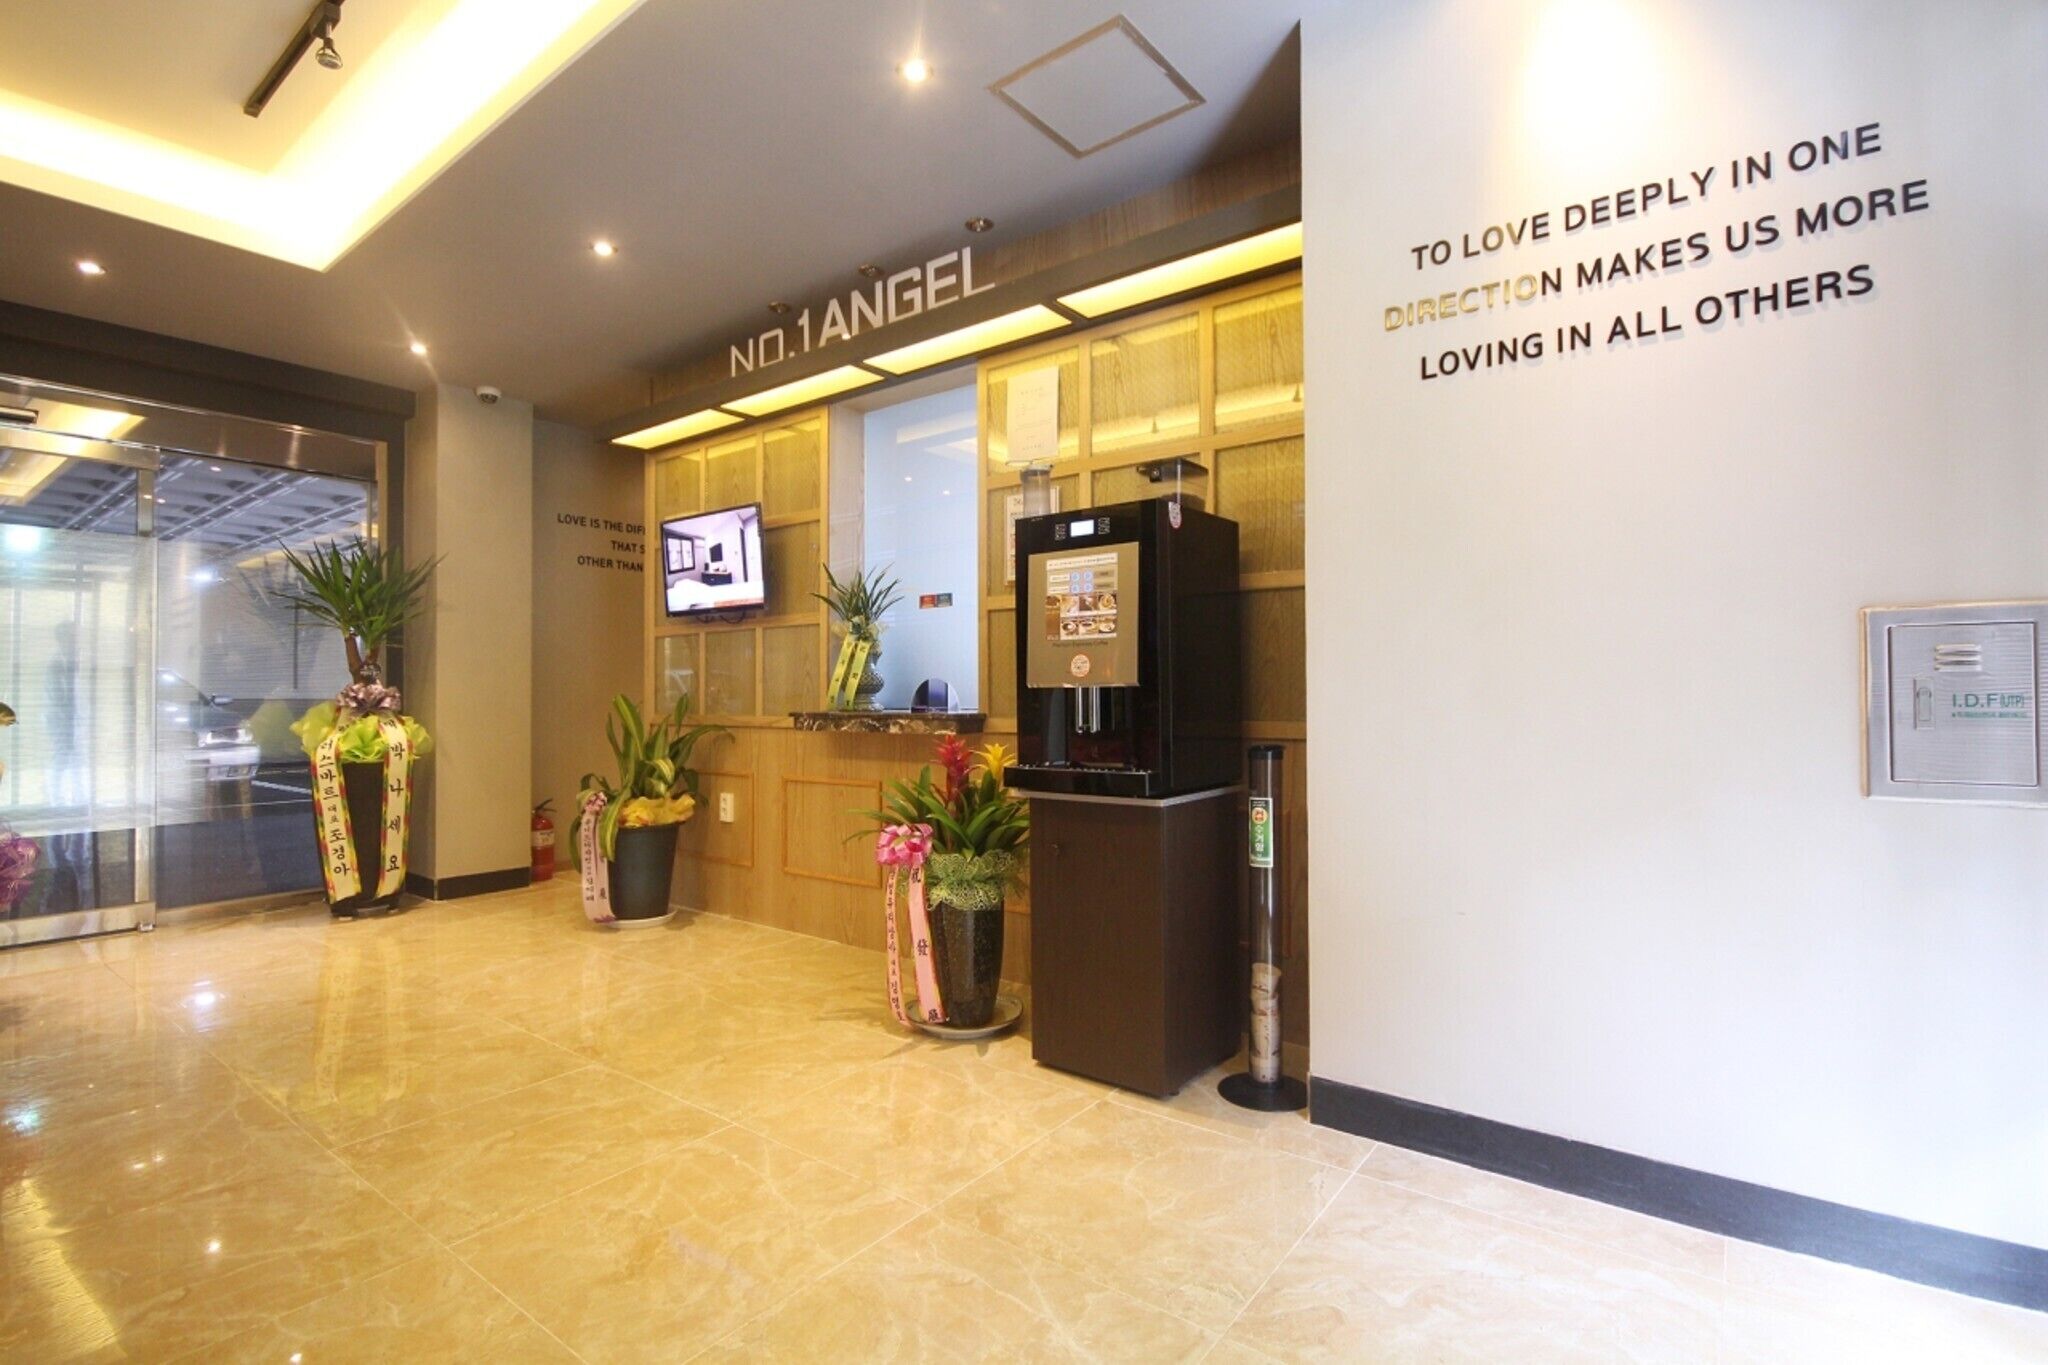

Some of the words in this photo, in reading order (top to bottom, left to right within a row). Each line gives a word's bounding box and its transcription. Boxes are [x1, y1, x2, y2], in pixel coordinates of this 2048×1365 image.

[1411, 239, 1451, 270] TO
[1463, 212, 1550, 258] LOVE
[1564, 166, 1715, 232] DEEPLY
[1731, 151, 1772, 188] IN
[1787, 122, 1882, 172] ONE
[1384, 267, 1562, 331] DIRECTION
[1577, 231, 1710, 288] MAKES
[1725, 214, 1780, 252] US
[1795, 179, 1930, 237] MORE
[1420, 332, 1543, 380] LOVING
[1556, 321, 1592, 354] IN
[1606, 305, 1682, 344] ALL
[1695, 264, 1874, 325] OTHERS
[557, 513, 586, 526] LOVE
[590, 518, 601, 529] IS
[603, 520, 624, 533] THE
[611, 540, 637, 553] THAT
[577, 555, 613, 569] OTHER
[616, 560, 644, 572] THAN
